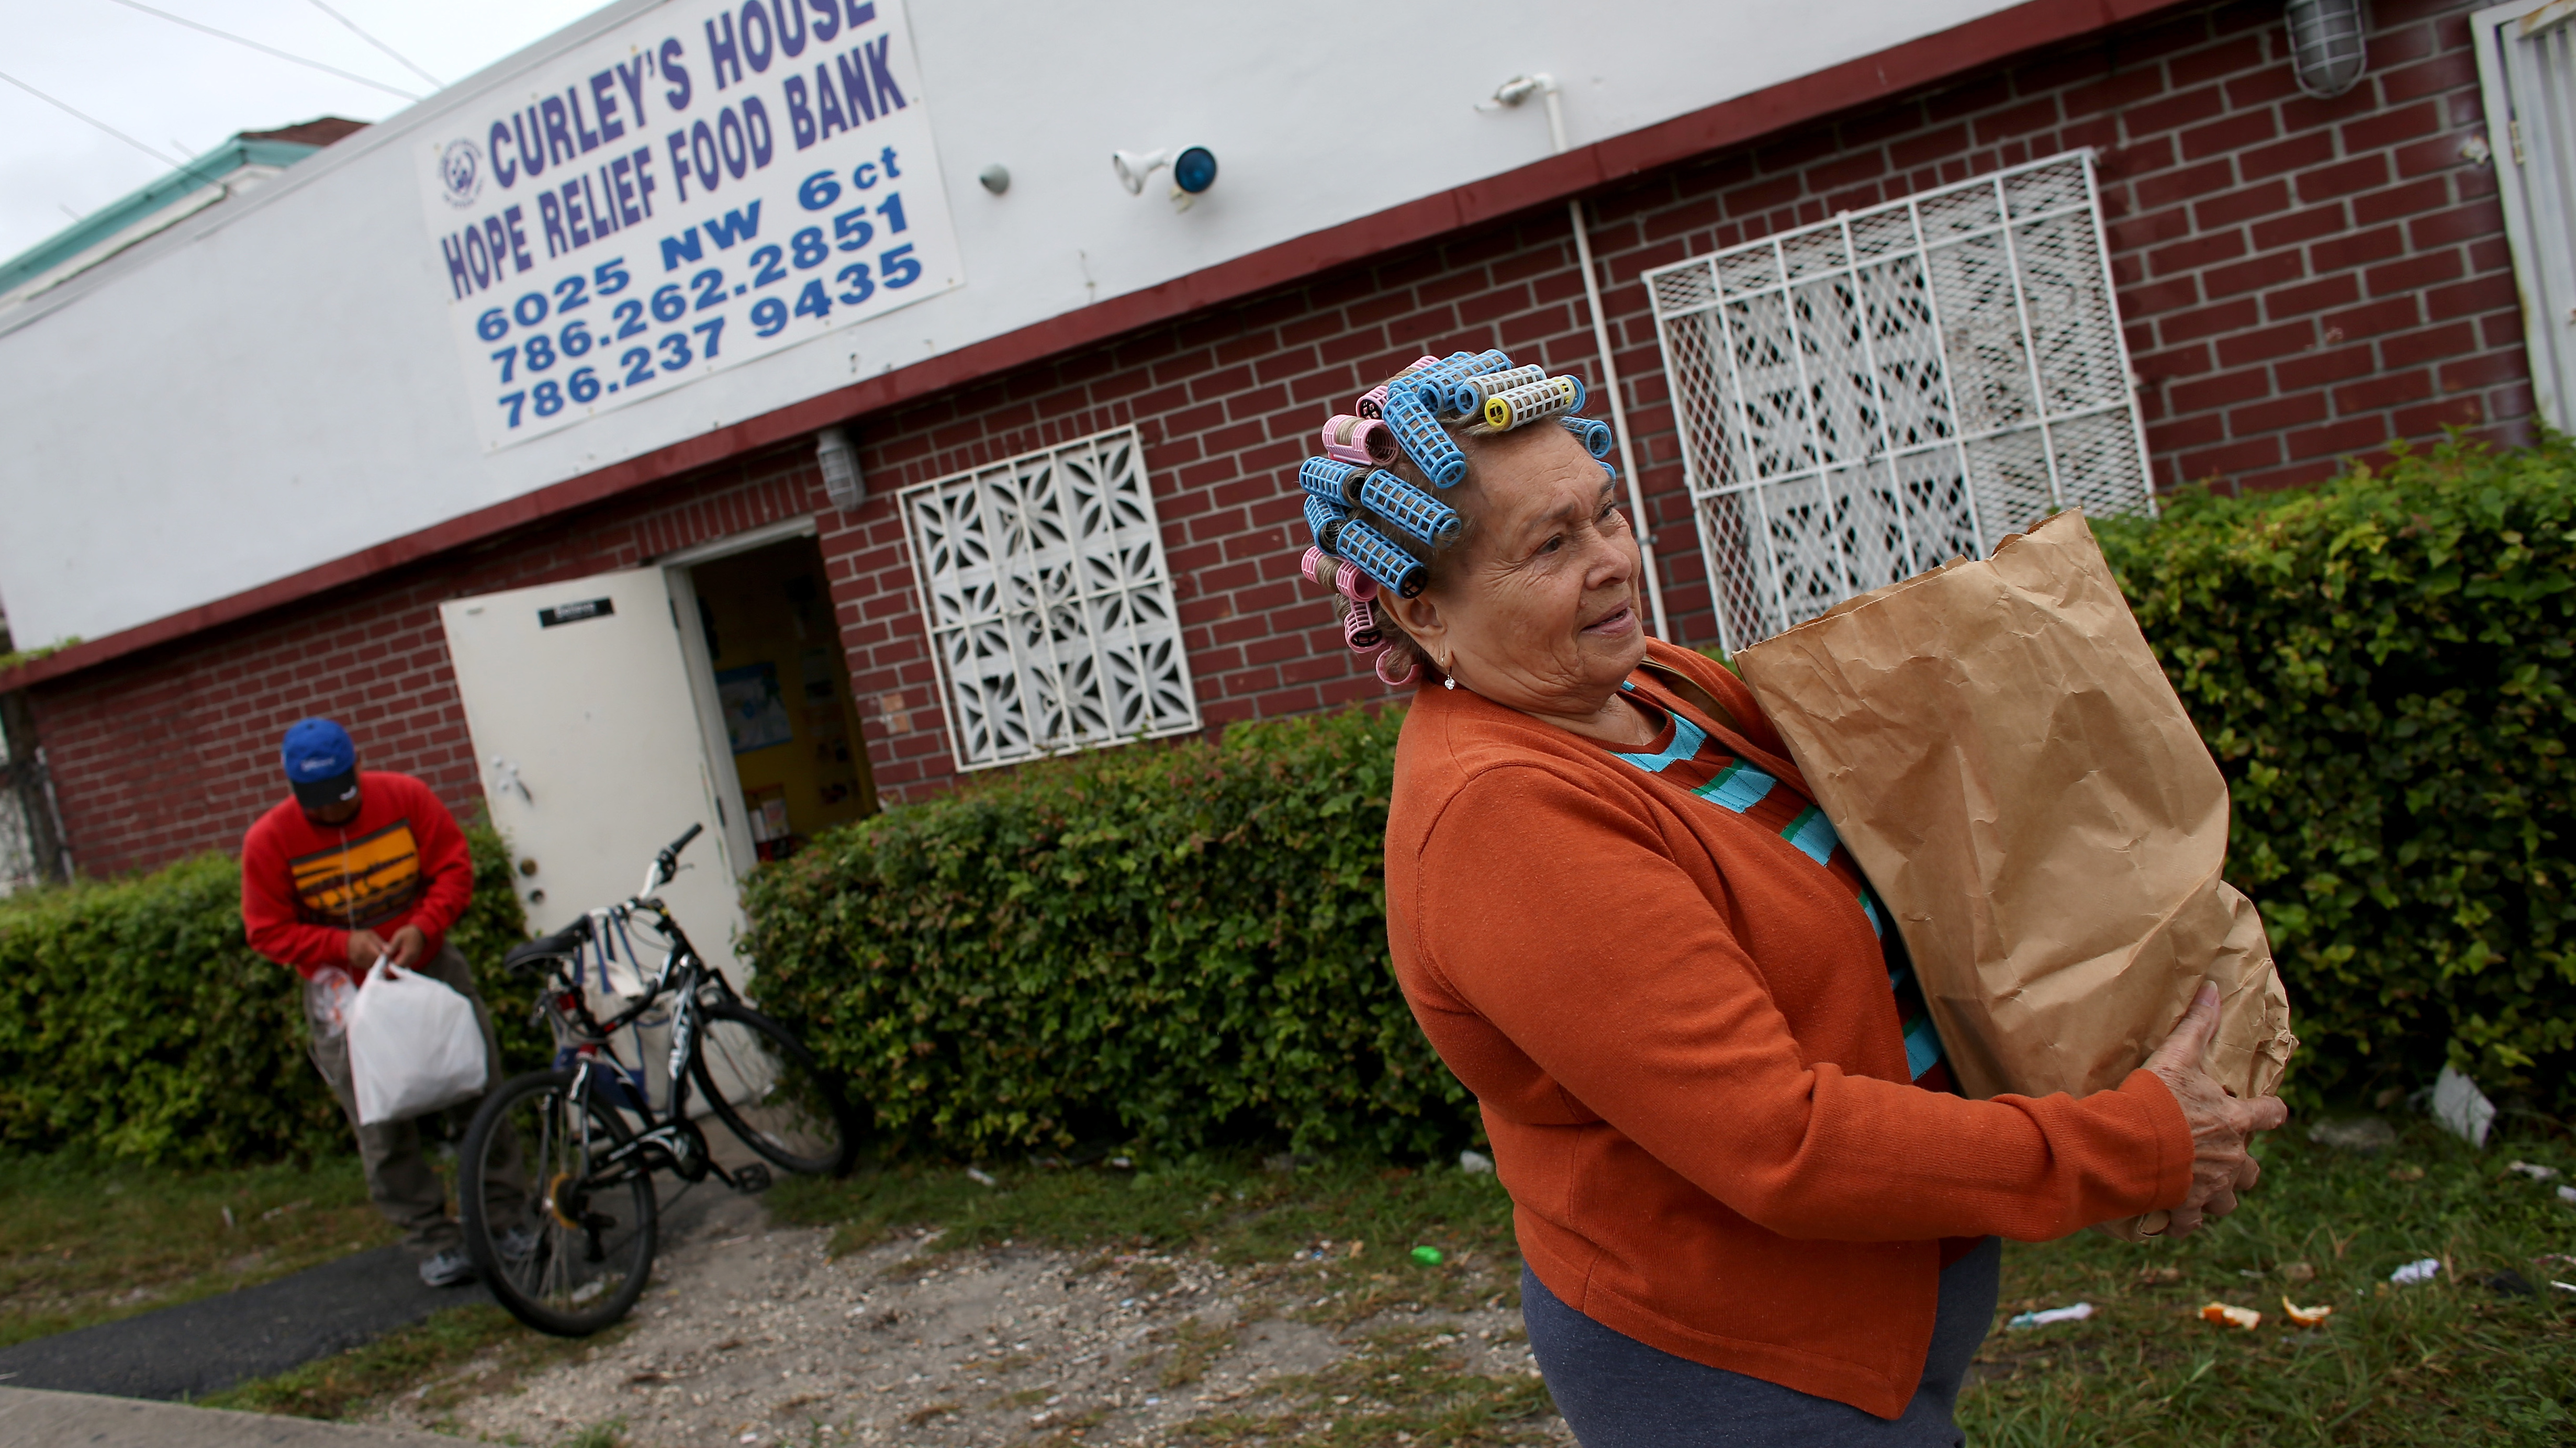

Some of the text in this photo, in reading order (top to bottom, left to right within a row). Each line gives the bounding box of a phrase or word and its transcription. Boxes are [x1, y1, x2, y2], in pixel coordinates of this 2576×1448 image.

[440, 203, 532, 300] HOPE
[536, 145, 655, 259] RELIEF
[666, 95, 772, 203] FOOD
[782, 32, 907, 150] BANK
[488, 36, 691, 189] CURLEY'S
[475, 145, 901, 343] 6025 NW 6 ct
[490, 191, 908, 385] 786.262.2851
[497, 241, 922, 429] 786.237 9435
